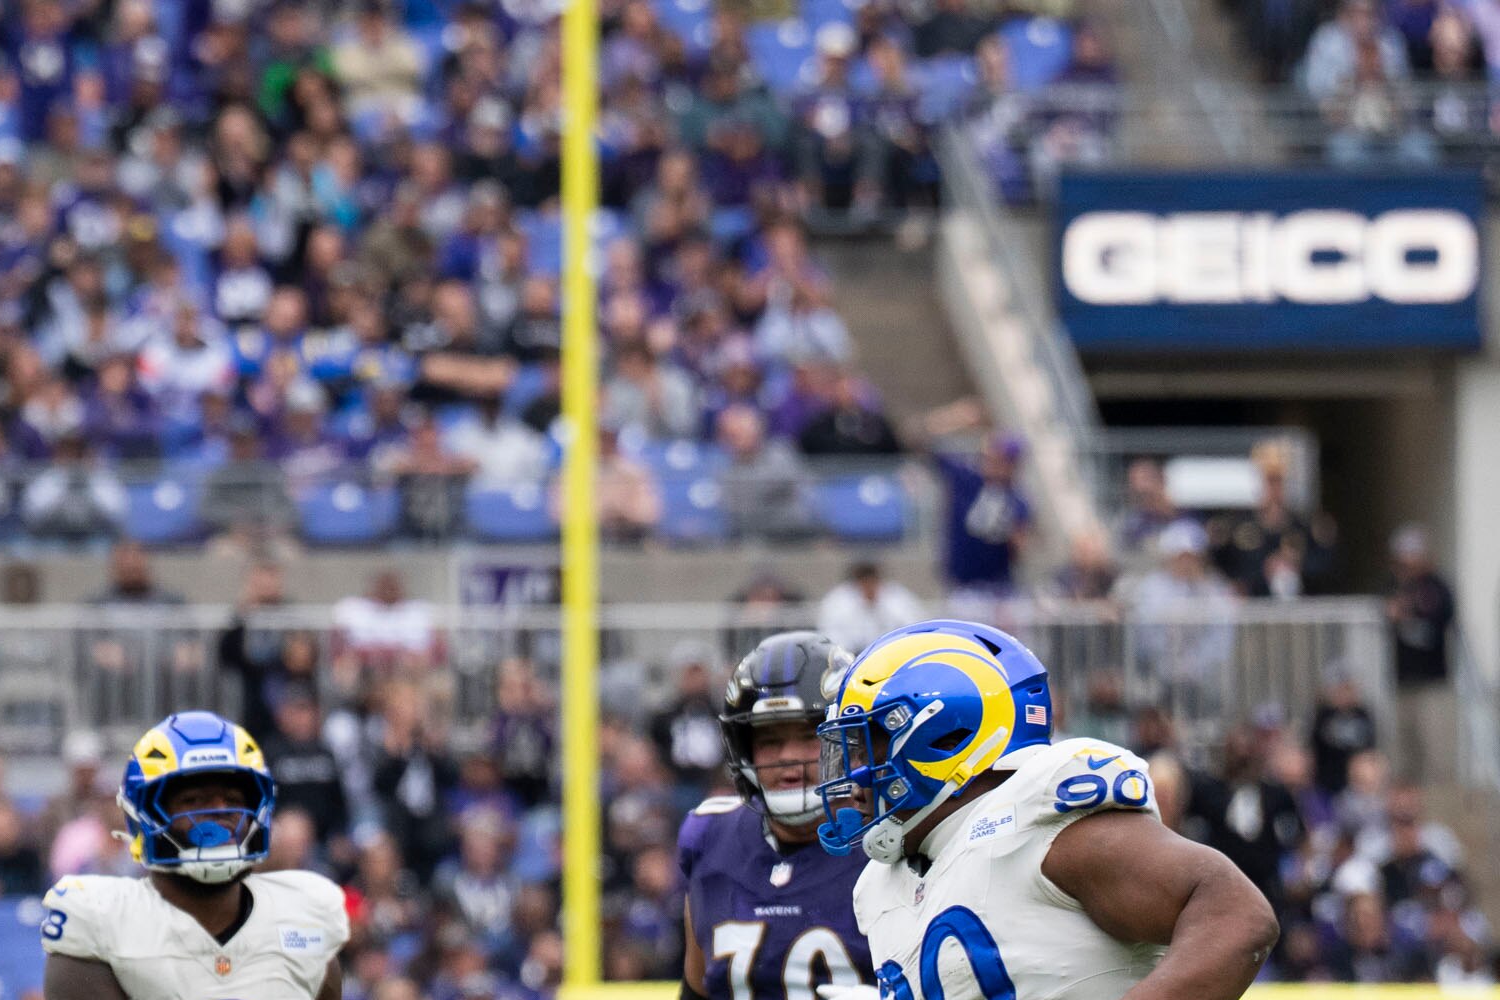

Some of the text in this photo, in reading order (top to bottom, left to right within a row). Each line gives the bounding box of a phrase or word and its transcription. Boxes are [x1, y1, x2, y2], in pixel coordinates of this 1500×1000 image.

[1063, 209, 1478, 305] GEICO
[1054, 769, 1148, 813] 90
[969, 827, 997, 841] RAMS
[970, 815, 1013, 835] ANGELES
[754, 905, 801, 916] RAVENS
[41, 909, 67, 941] 8
